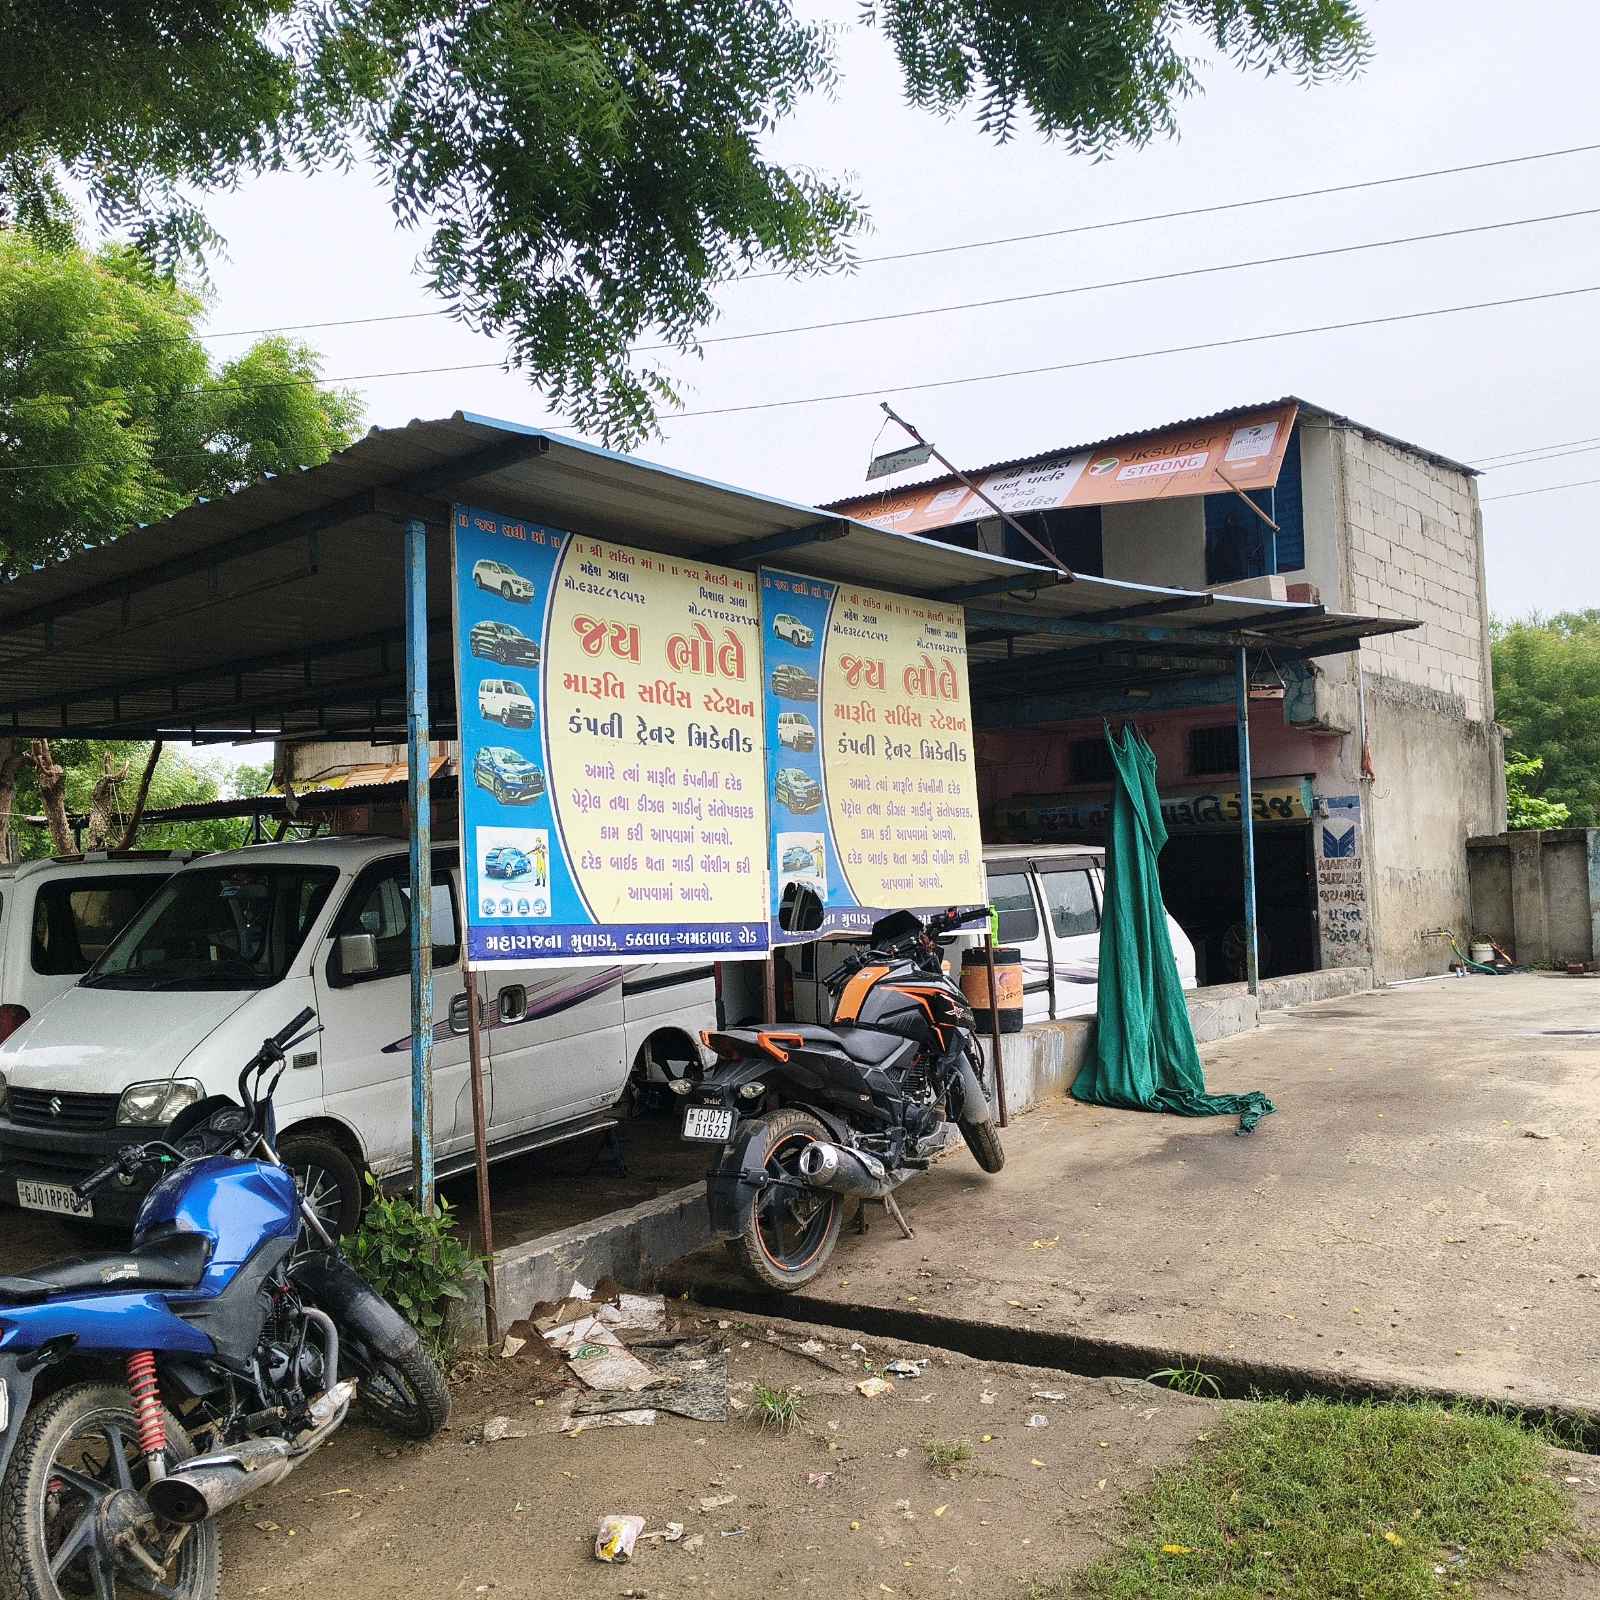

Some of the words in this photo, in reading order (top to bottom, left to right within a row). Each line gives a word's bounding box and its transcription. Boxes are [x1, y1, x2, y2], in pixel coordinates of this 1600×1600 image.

[1127, 457, 1199, 478] STRONG
[474, 518, 497, 534] જય
[579, 560, 602, 577] મહેશ
[607, 569, 629, 583] ઝાલા
[589, 544, 603, 558] શ્રી
[682, 567, 700, 581] જય
[698, 586, 725, 604] વિશાલ
[729, 596, 748, 609] ઝાલા
[572, 614, 641, 665] જય
[665, 620, 746, 681] ભોલે
[839, 653, 886, 691] જય
[903, 652, 960, 702] ભોલે
[563, 671, 625, 700] મારૂતિ
[638, 679, 692, 709] સર્વિસ
[703, 687, 755, 718] સ્ટેશન
[834, 700, 876, 724] મારૂતિ
[884, 704, 922, 728] સર્વિસ
[930, 709, 967, 732] સ્ટેશન
[568, 708, 623, 739] કંપની
[636, 715, 675, 746] ટ્રેનર
[688, 723, 753, 753] મિકેનીક
[838, 732, 875, 756] કંપની
[884, 735, 912, 761] ટ્રેનર
[584, 761, 615, 780] અમારે
[622, 763, 640, 783] ત્યાં
[647, 766, 676, 788] મારૂતિ
[725, 773, 743, 792] દરેક
[849, 774, 871, 792] અમારે
[948, 781, 961, 794] દરેક
[571, 788, 601, 814] પેટ્રોલ
[609, 796, 630, 812] તથા
[637, 793, 665, 813] ડીઝલ
[672, 797, 703, 821] ગાડીનું
[841, 798, 861, 817] પેટ્રોલ
[867, 803, 881, 816] તથા
[887, 800, 905, 816] ડીઝલ
[600, 825, 620, 841] કામ
[627, 823, 643, 841] કરી
[650, 825, 694, 844] આપવામાં
[701, 827, 733, 846] આવશે.
[861, 828, 874, 841] કામ
[880, 826, 891, 841] કરી
[896, 826, 928, 841] આપવામાં
[581, 850, 602, 870] દરેક
[609, 854, 638, 871] બાઈક
[672, 853, 694, 872] ગાડી
[736, 858, 751, 874] કરી
[848, 848, 863, 864] દરેક
[912, 850, 928, 865] ગાડી
[959, 851, 970, 865] કરી
[627, 882, 673, 901] આપવામાં
[680, 883, 713, 902] આવશે.
[881, 874, 914, 889] આપવામાં
[485, 934, 562, 951] મહારાજના
[738, 925, 757, 944] રોડ
[697, 1109, 729, 1124] GJ07E
